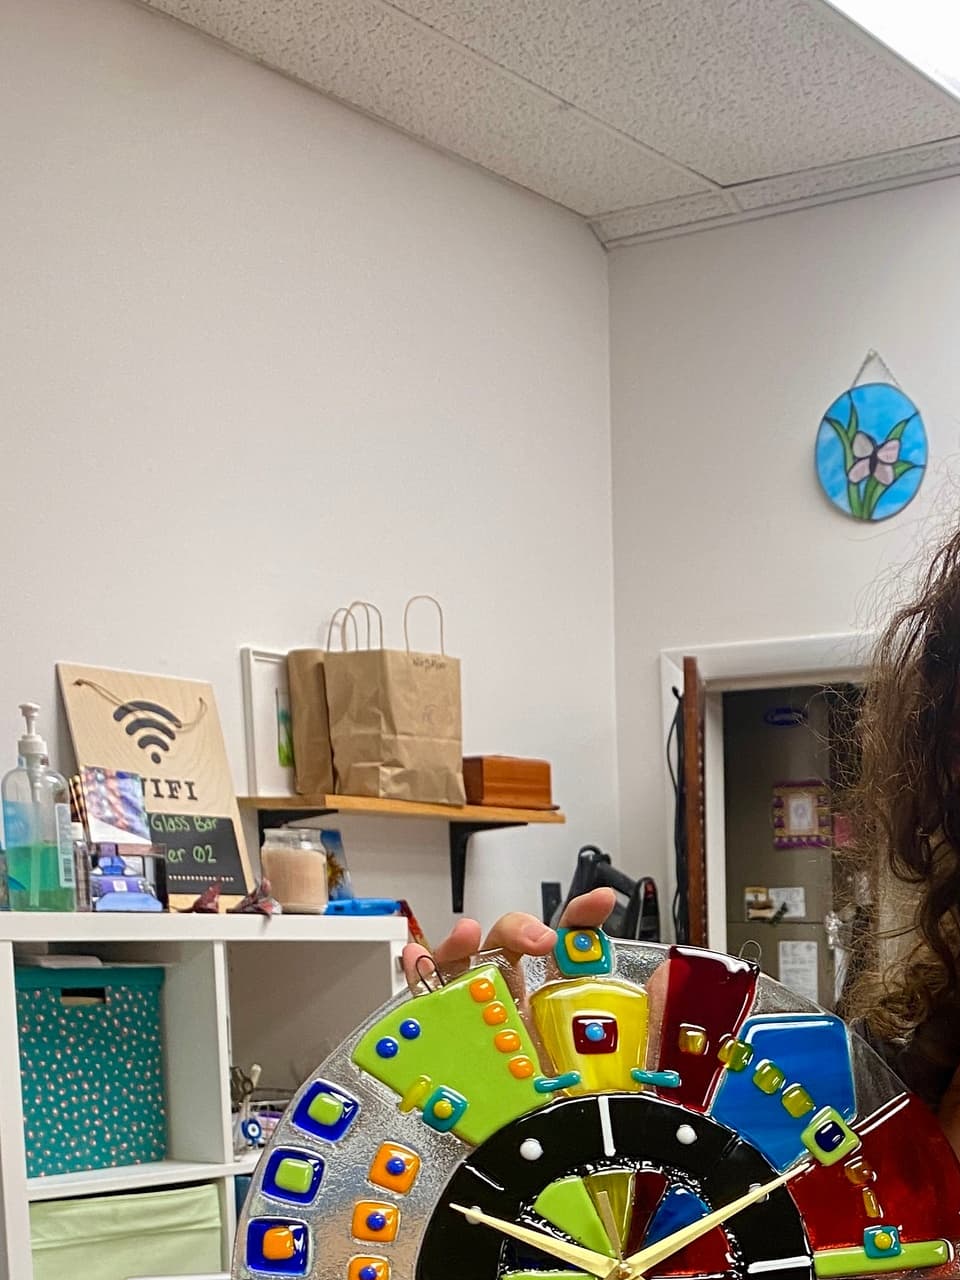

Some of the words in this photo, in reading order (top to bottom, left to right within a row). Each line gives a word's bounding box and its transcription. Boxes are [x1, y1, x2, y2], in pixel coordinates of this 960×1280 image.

[143, 778, 199, 801] IFI
[151, 813, 191, 832] Glass
[193, 815, 217, 832] Bar
[167, 848, 186, 863] er
